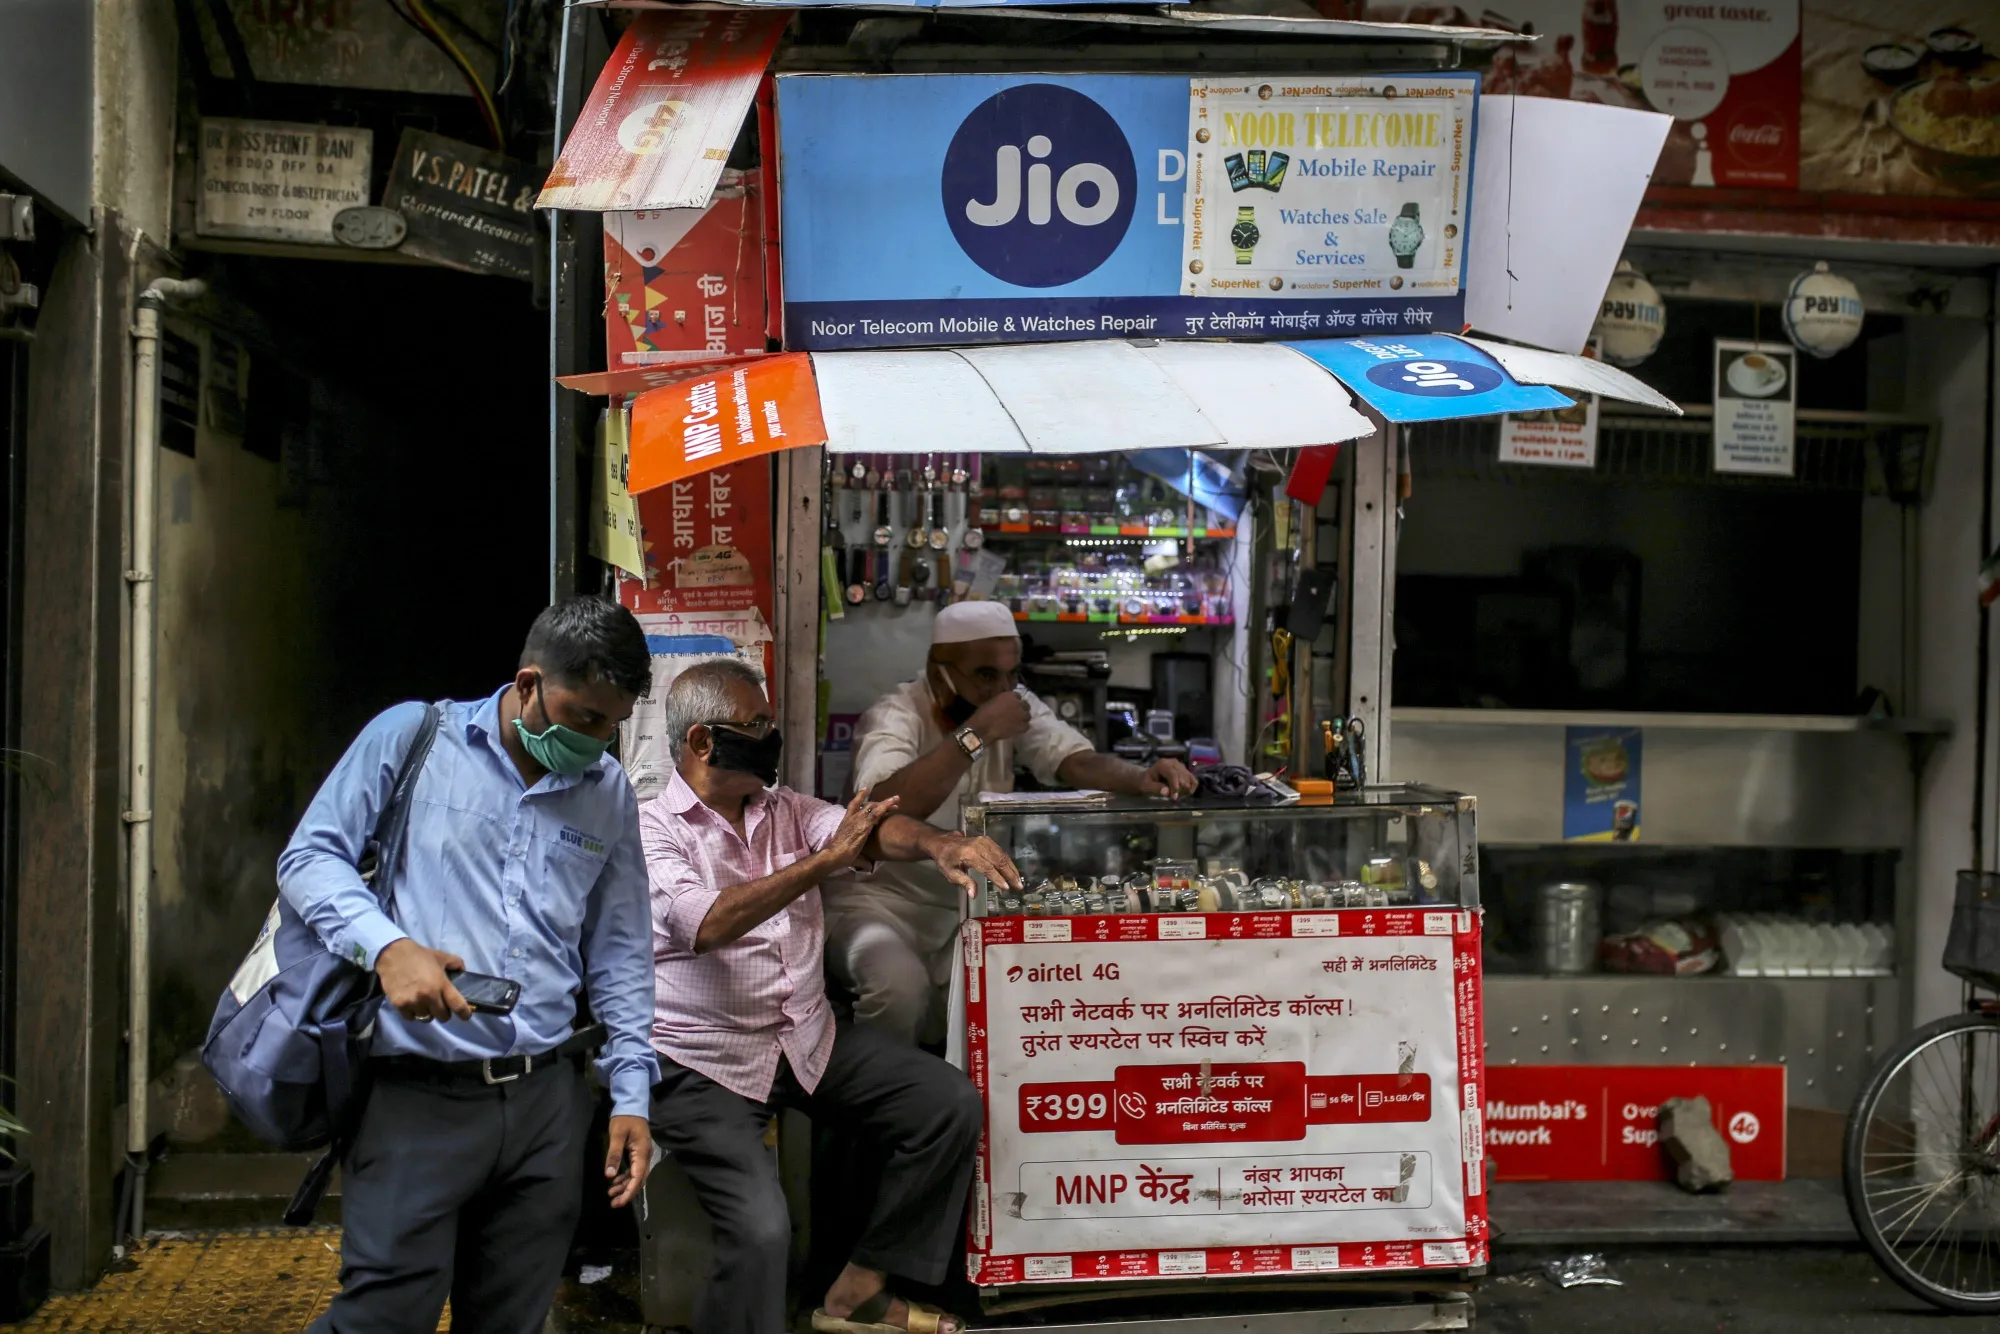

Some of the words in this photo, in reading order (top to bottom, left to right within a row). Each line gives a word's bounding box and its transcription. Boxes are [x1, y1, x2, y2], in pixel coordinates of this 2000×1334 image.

[1664, 3, 1714, 21] great
[608, 65, 635, 91] Strong
[1281, 85, 1332, 98] SuperNet
[1405, 87, 1456, 99] SuperNet
[594, 91, 621, 127] Network
[1221, 111, 1295, 148] NOOR
[1303, 112, 1441, 149] TELECOME
[1451, 117, 1463, 172] SuperNet
[1297, 158, 1367, 178] Mobile
[1372, 159, 1437, 183] Repair
[965, 135, 1120, 227] Jio
[272, 208, 310, 221] FLOOR
[401, 194, 475, 229] Chartered
[1279, 208, 1349, 225] Watches
[1353, 208, 1388, 225] Sale
[1192, 197, 1205, 251] SuperNet
[1323, 231, 1340, 247] &
[1295, 250, 1365, 265] Services
[1211, 278, 1262, 290] SuperNet
[1332, 280, 1382, 291] SuperNet
[811, 320, 855, 336] Noor
[860, 319, 933, 335] Telecom
[940, 317, 998, 333] Mobile
[1003, 317, 1016, 332] &
[1021, 315, 1096, 332] Watches
[1101, 314, 1157, 334] Repair
[1210, 311, 1265, 330] टेलीकॉम
[1270, 310, 1320, 331] मोबाईल
[1361, 308, 1398, 326] वॉचेस
[1404, 306, 1433, 325] रीपैर
[1401, 361, 1475, 391] Jio
[682, 380, 719, 424] Centre
[761, 400, 780, 423] number
[767, 422, 787, 439] your
[684, 423, 722, 462] MNP
[714, 551, 732, 559] 4G
[657, 597, 678, 605] airtel
[662, 604, 673, 612] 4G
[560, 830, 583, 847] BLUE
[1027, 963, 1083, 983] airtel
[1092, 963, 1120, 981] 4G
[1322, 956, 1347, 973] सही
[1351, 956, 1365, 971] में
[1369, 955, 1438, 971] अनलिमिटेड
[1461, 952, 1469, 974] airtel
[1020, 998, 1066, 1023] सभी
[1070, 997, 1136, 1021] नेटवर्क
[1140, 1002, 1169, 1020] पर
[1177, 995, 1283, 1019] अनलिमिटेड
[1020, 1031, 1063, 1058] तुरंत
[1067, 1027, 1142, 1050] एयरटेल
[1146, 1032, 1175, 1048] पर
[1179, 1025, 1230, 1048] स्विच
[1234, 1024, 1268, 1047] करें
[1161, 1073, 1192, 1090] सभी
[1244, 1074, 1265, 1089] पर
[1026, 1093, 1107, 1121] ₹399
[1155, 1096, 1229, 1115] अनलिमिटेड
[1233, 1097, 1273, 1114] कॉल्स
[1486, 1101, 1587, 1121] Mumbai's
[1182, 1122, 1199, 1131] बिना
[1200, 1121, 1227, 1131] अतिरिक्त
[1228, 1122, 1246, 1132] शुल्क
[1486, 1126, 1552, 1145] twork
[1732, 1118, 1757, 1137] 4G
[1622, 1126, 1659, 1148] Sup
[1056, 1174, 1128, 1205] MNP
[1135, 1163, 1194, 1205] केंद्र
[1242, 1165, 1283, 1185] नंबर
[1289, 1166, 1345, 1183] आपका
[1242, 1185, 1295, 1207] भरोसा
[1301, 1183, 1367, 1205] एयरटेल
[1371, 1187, 1395, 1203] का
